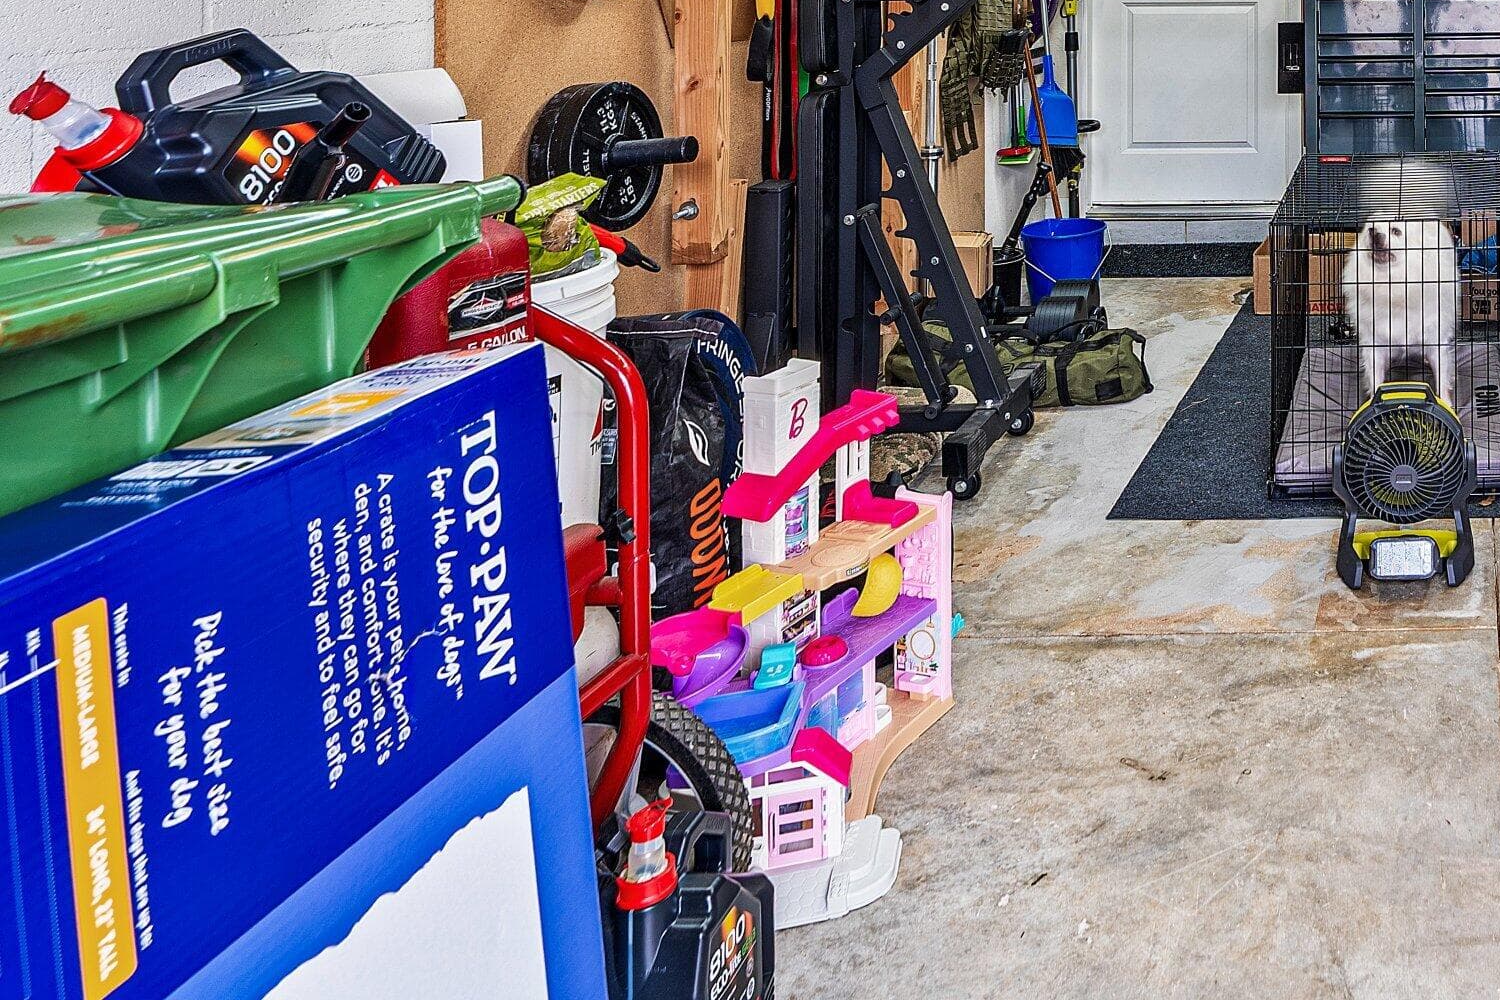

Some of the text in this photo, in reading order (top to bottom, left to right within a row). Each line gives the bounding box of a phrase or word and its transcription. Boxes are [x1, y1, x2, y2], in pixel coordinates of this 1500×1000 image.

[239, 129, 297, 202] 8100
[354, 482, 372, 532] den,
[376, 472, 394, 491] A
[427, 465, 452, 502] for
[377, 494, 396, 552] crate
[431, 506, 457, 550] the
[358, 533, 376, 576] and
[384, 552, 399, 573] is
[435, 550, 459, 601] love
[361, 576, 385, 654] comfort
[382, 573, 401, 624] your
[438, 602, 465, 636] of
[307, 517, 346, 791] security and to feel safe.
[331, 517, 370, 755] where they can go for
[72, 624, 99, 771] MEDIUM-LARGE
[192, 611, 234, 838] Pick the best size
[154, 666, 199, 829] for your dog
[97, 929, 119, 983] TALL
[710, 913, 745, 982] 8100
